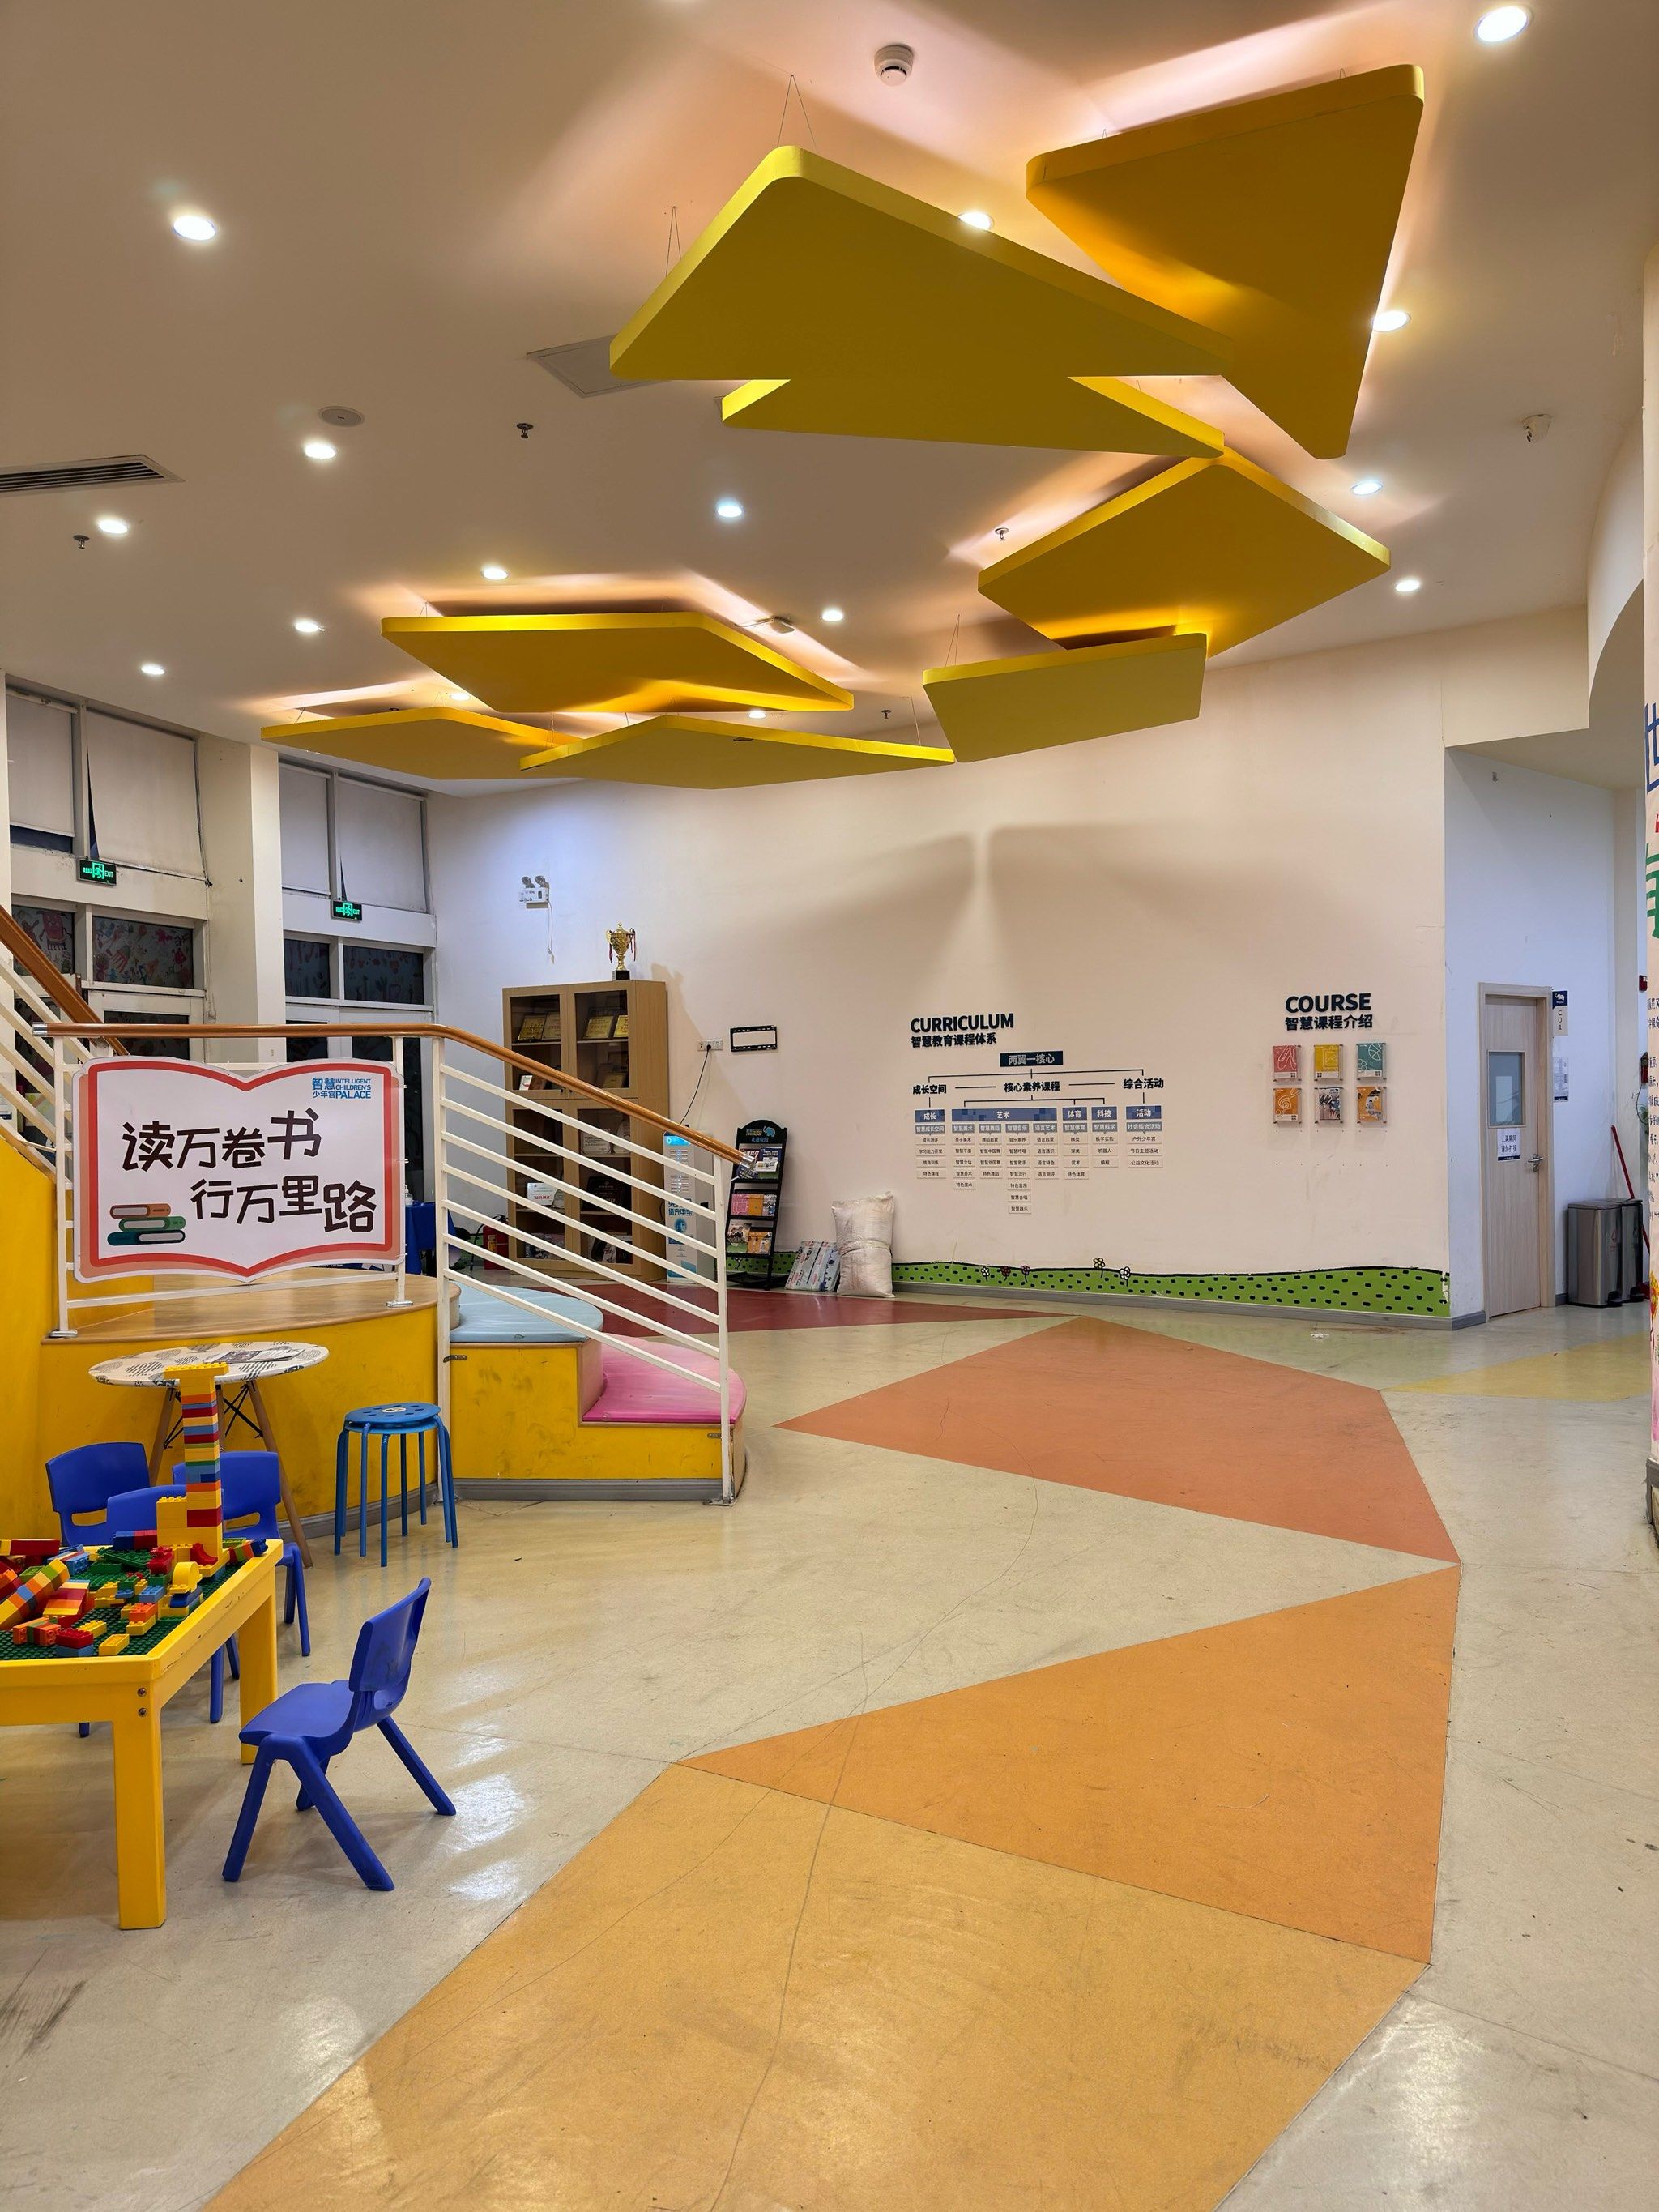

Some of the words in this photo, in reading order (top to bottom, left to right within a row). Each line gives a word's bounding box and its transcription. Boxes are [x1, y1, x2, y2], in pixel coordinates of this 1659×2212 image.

[1285, 993, 1372, 1014] COURSE
[911, 1013, 1014, 1033] CURRICULUM
[1285, 1014, 1373, 1031] 智慧课程介绍
[910, 1032, 998, 1048] 智慧教育课程体系
[1007, 1053, 1056, 1065] 两翼一核心
[312, 1078, 335, 1091] 智慧
[912, 1084, 947, 1095] 成长空间
[1004, 1081, 1060, 1093] 核心素养课程
[1123, 1078, 1164, 1090] 综合活动
[312, 1091, 335, 1099] 少年宫
[335, 1091, 372, 1099] PALACE
[923, 1112, 936, 1121] 成长
[996, 1111, 1010, 1119] 艺术
[1067, 1110, 1081, 1118] 体育
[1097, 1109, 1111, 1118] 科技
[1136, 1108, 1152, 1117] 活动
[122, 1107, 322, 1172] 读万卷书
[190, 1175, 377, 1232] 行万里路
